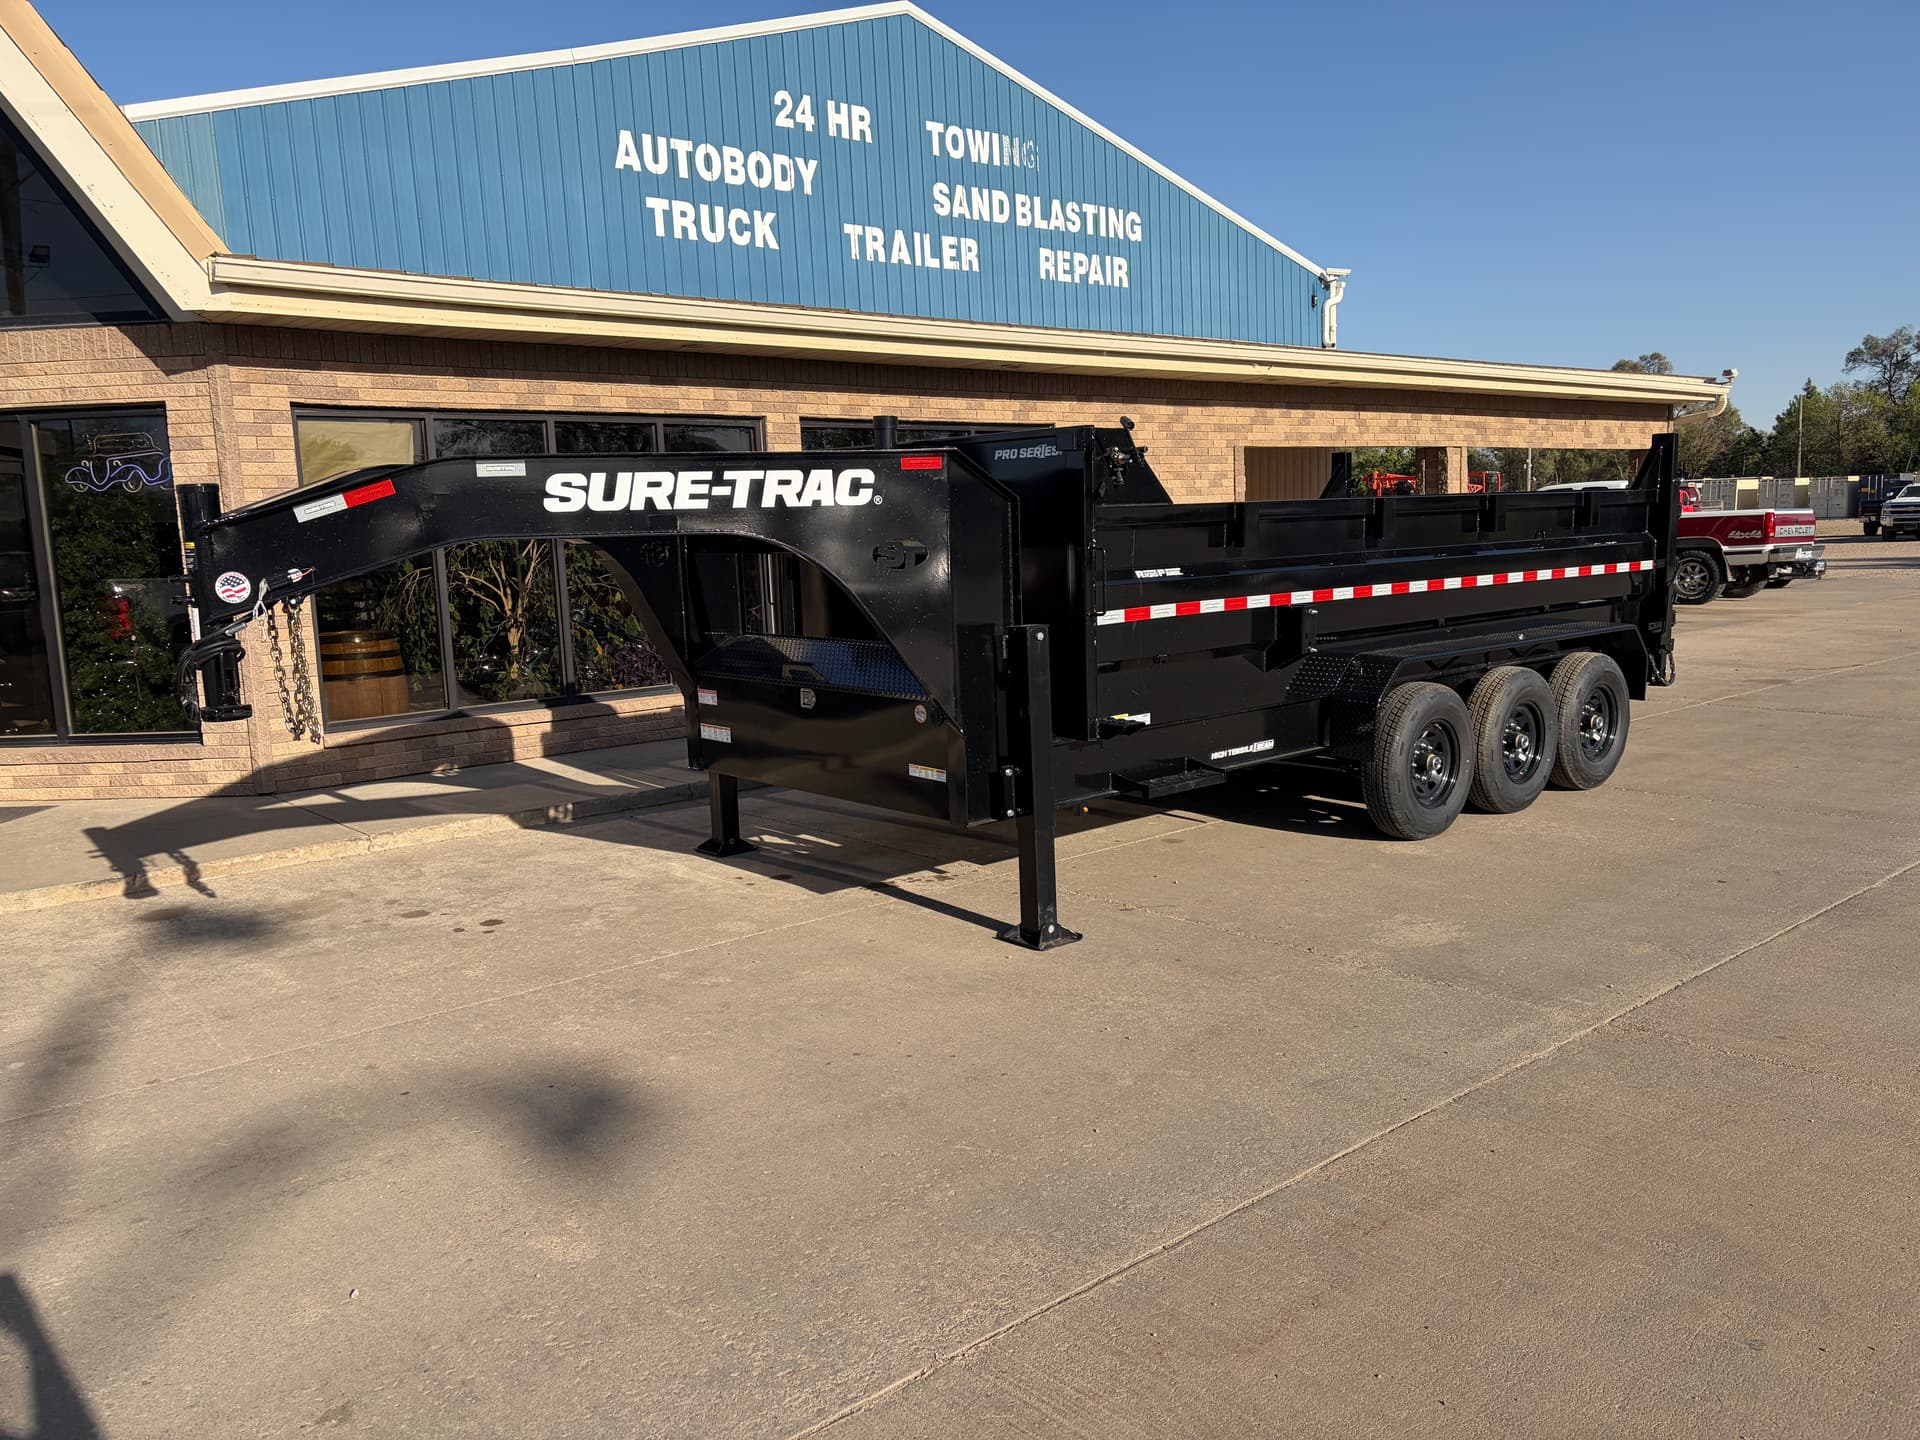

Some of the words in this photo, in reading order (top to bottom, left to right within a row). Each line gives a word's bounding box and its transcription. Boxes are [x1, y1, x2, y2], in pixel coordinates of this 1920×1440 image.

[615, 129, 818, 196] AUTOBODY
[774, 90, 815, 132] 24
[827, 100, 873, 143] HR
[926, 120, 1041, 172] TOWING
[646, 197, 780, 250] TRUCK
[843, 223, 980, 272] TRAILER
[1040, 247, 1129, 288] REPAIR
[994, 448, 1018, 460] PRO
[1019, 443, 1059, 459] SERIES
[1779, 527, 1813, 536] CHEVROLET
